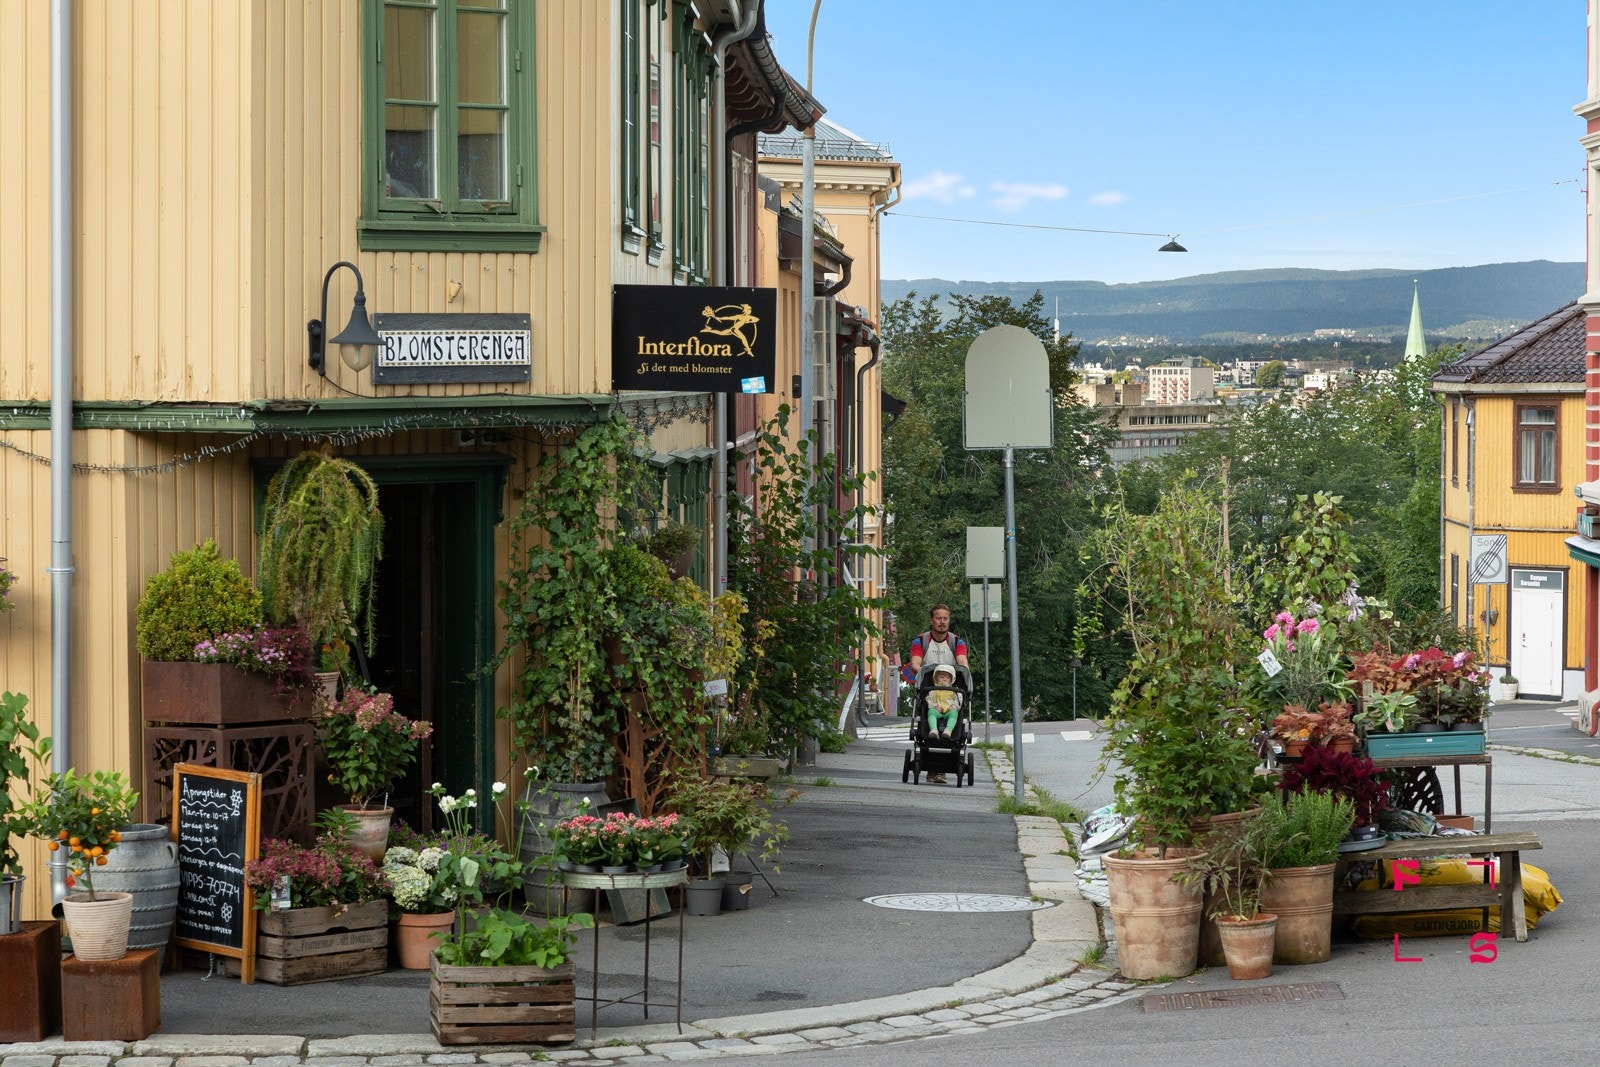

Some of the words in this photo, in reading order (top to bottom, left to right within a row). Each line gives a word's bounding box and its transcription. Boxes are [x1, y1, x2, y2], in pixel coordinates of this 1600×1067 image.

[385, 335, 525, 361] BLOMSTERENGA
[637, 336, 732, 357] Interflora
[637, 362, 649, 374] Si
[652, 363, 667, 372] det
[669, 364, 689, 373] med
[692, 364, 732, 374] blomster
